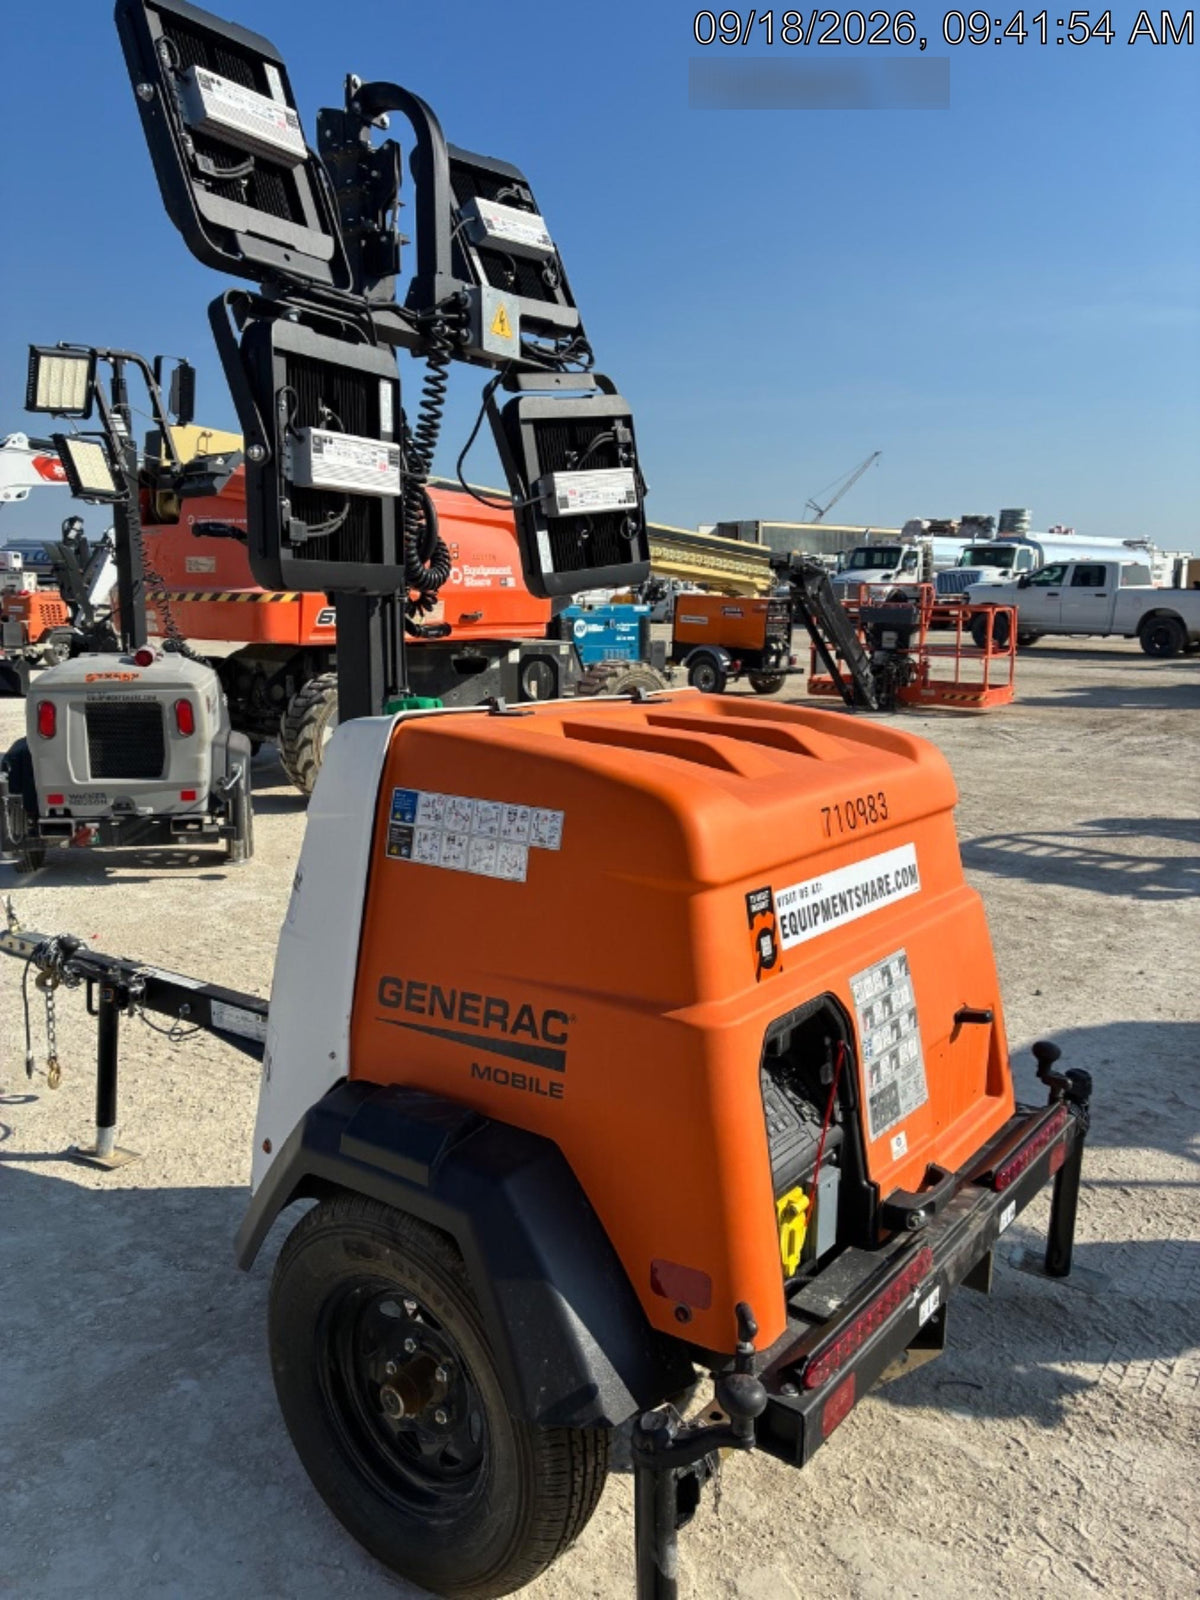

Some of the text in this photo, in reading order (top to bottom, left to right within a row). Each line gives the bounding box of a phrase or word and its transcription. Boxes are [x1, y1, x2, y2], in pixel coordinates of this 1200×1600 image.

[820, 791, 889, 837] 710983
[779, 862, 919, 940] EQUIPMENTSHARE.COM
[377, 975, 569, 1046] GENERAC
[470, 1062, 565, 1100] MOBILE
